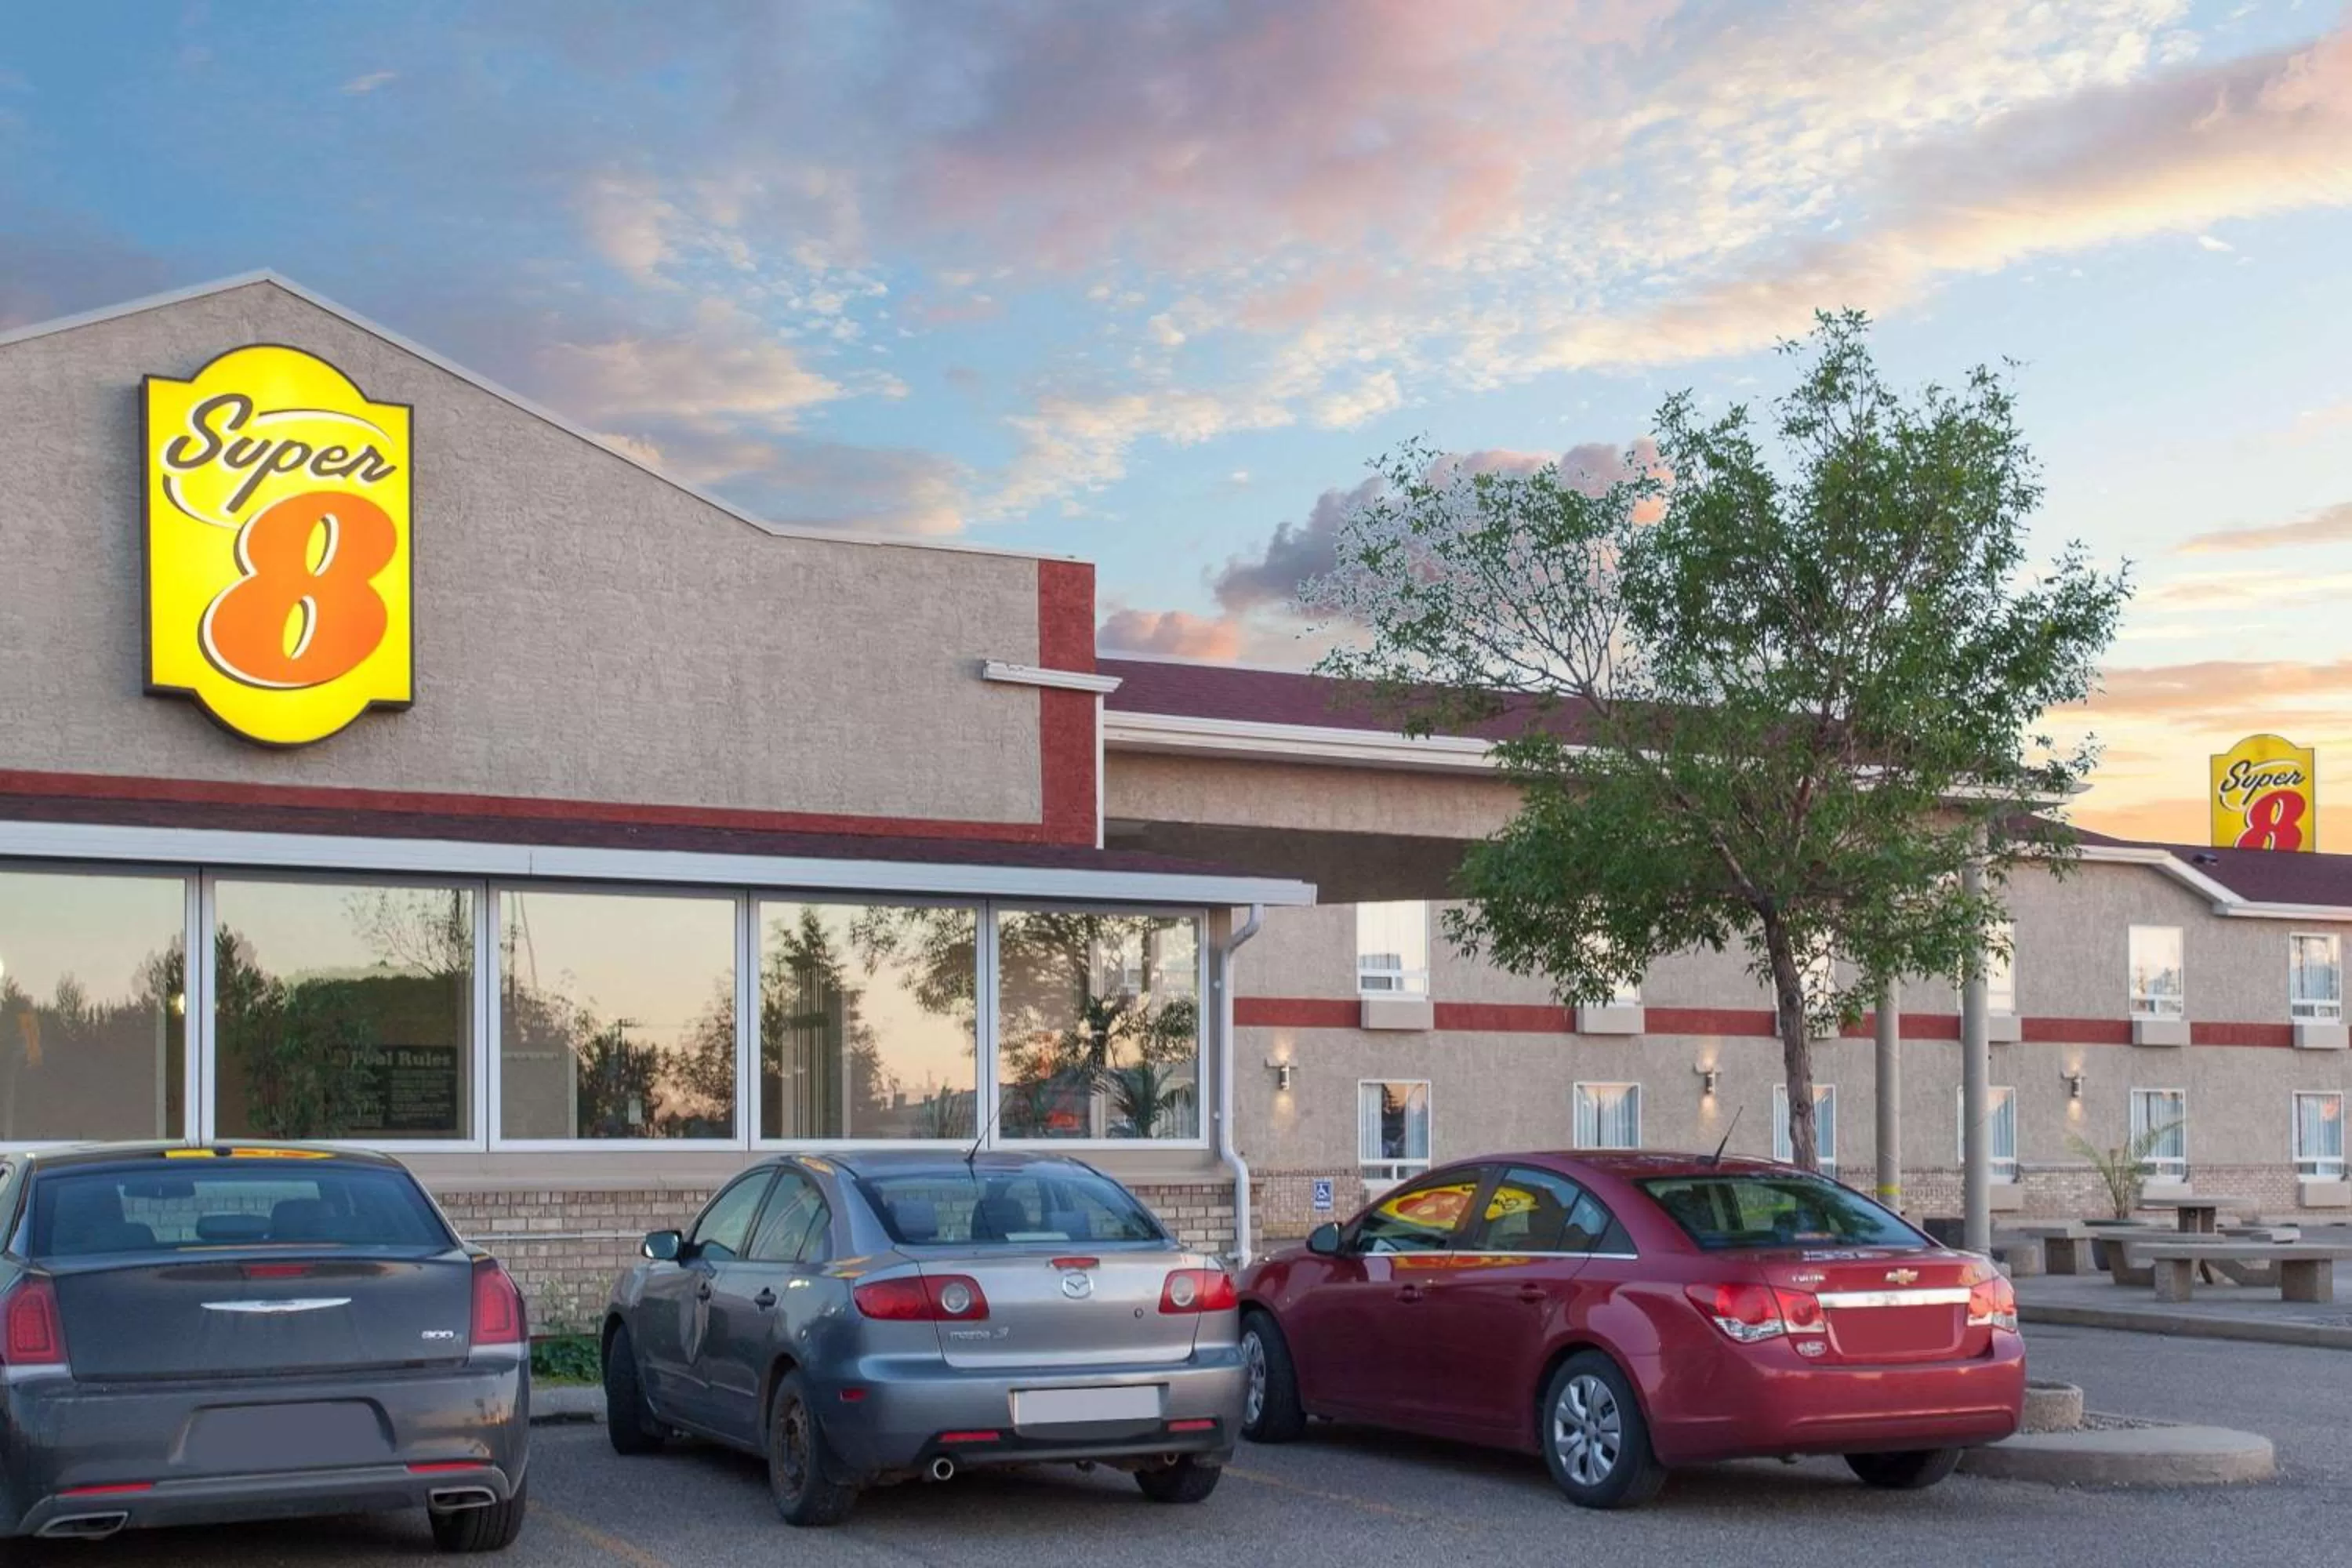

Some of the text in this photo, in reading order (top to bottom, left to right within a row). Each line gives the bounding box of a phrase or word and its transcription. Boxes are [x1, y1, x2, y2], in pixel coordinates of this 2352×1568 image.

[163, 392, 397, 514] Super
[198, 491, 398, 690] 8
[2220, 759, 2306, 805] Super
[2234, 789, 2306, 851] 8
[398, 1051, 452, 1067] Rules
